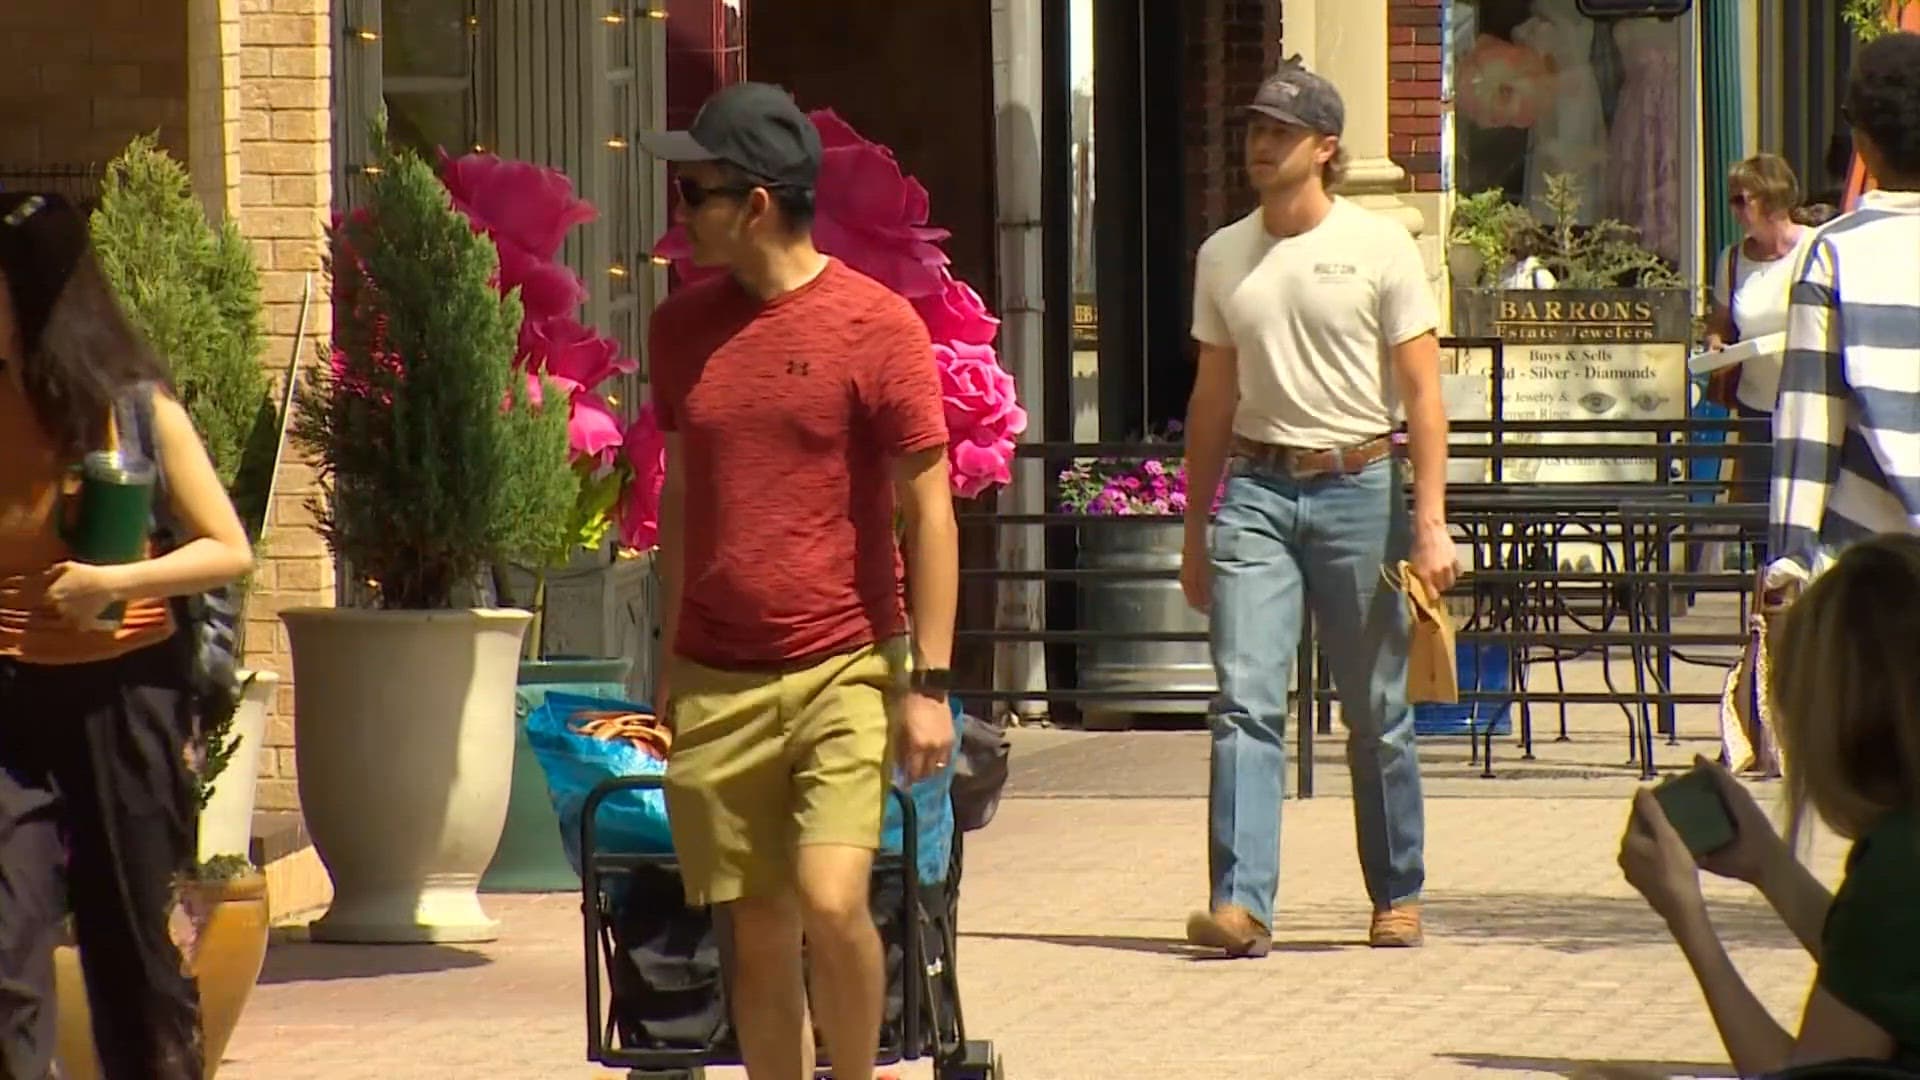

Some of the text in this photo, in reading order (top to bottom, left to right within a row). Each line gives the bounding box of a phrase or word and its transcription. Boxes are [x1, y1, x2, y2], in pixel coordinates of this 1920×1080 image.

[1501, 300, 1652, 321] BARRONS
[1495, 325, 1654, 339] Estate Jewelers
[1529, 350, 1612, 363] Buys & Sells
[1481, 367, 1516, 380] Gld
[1529, 366, 1570, 380] Silver
[1584, 365, 1657, 380] Diamonds
[1515, 391, 1555, 407] Jewelry
[1558, 390, 1570, 403] &
